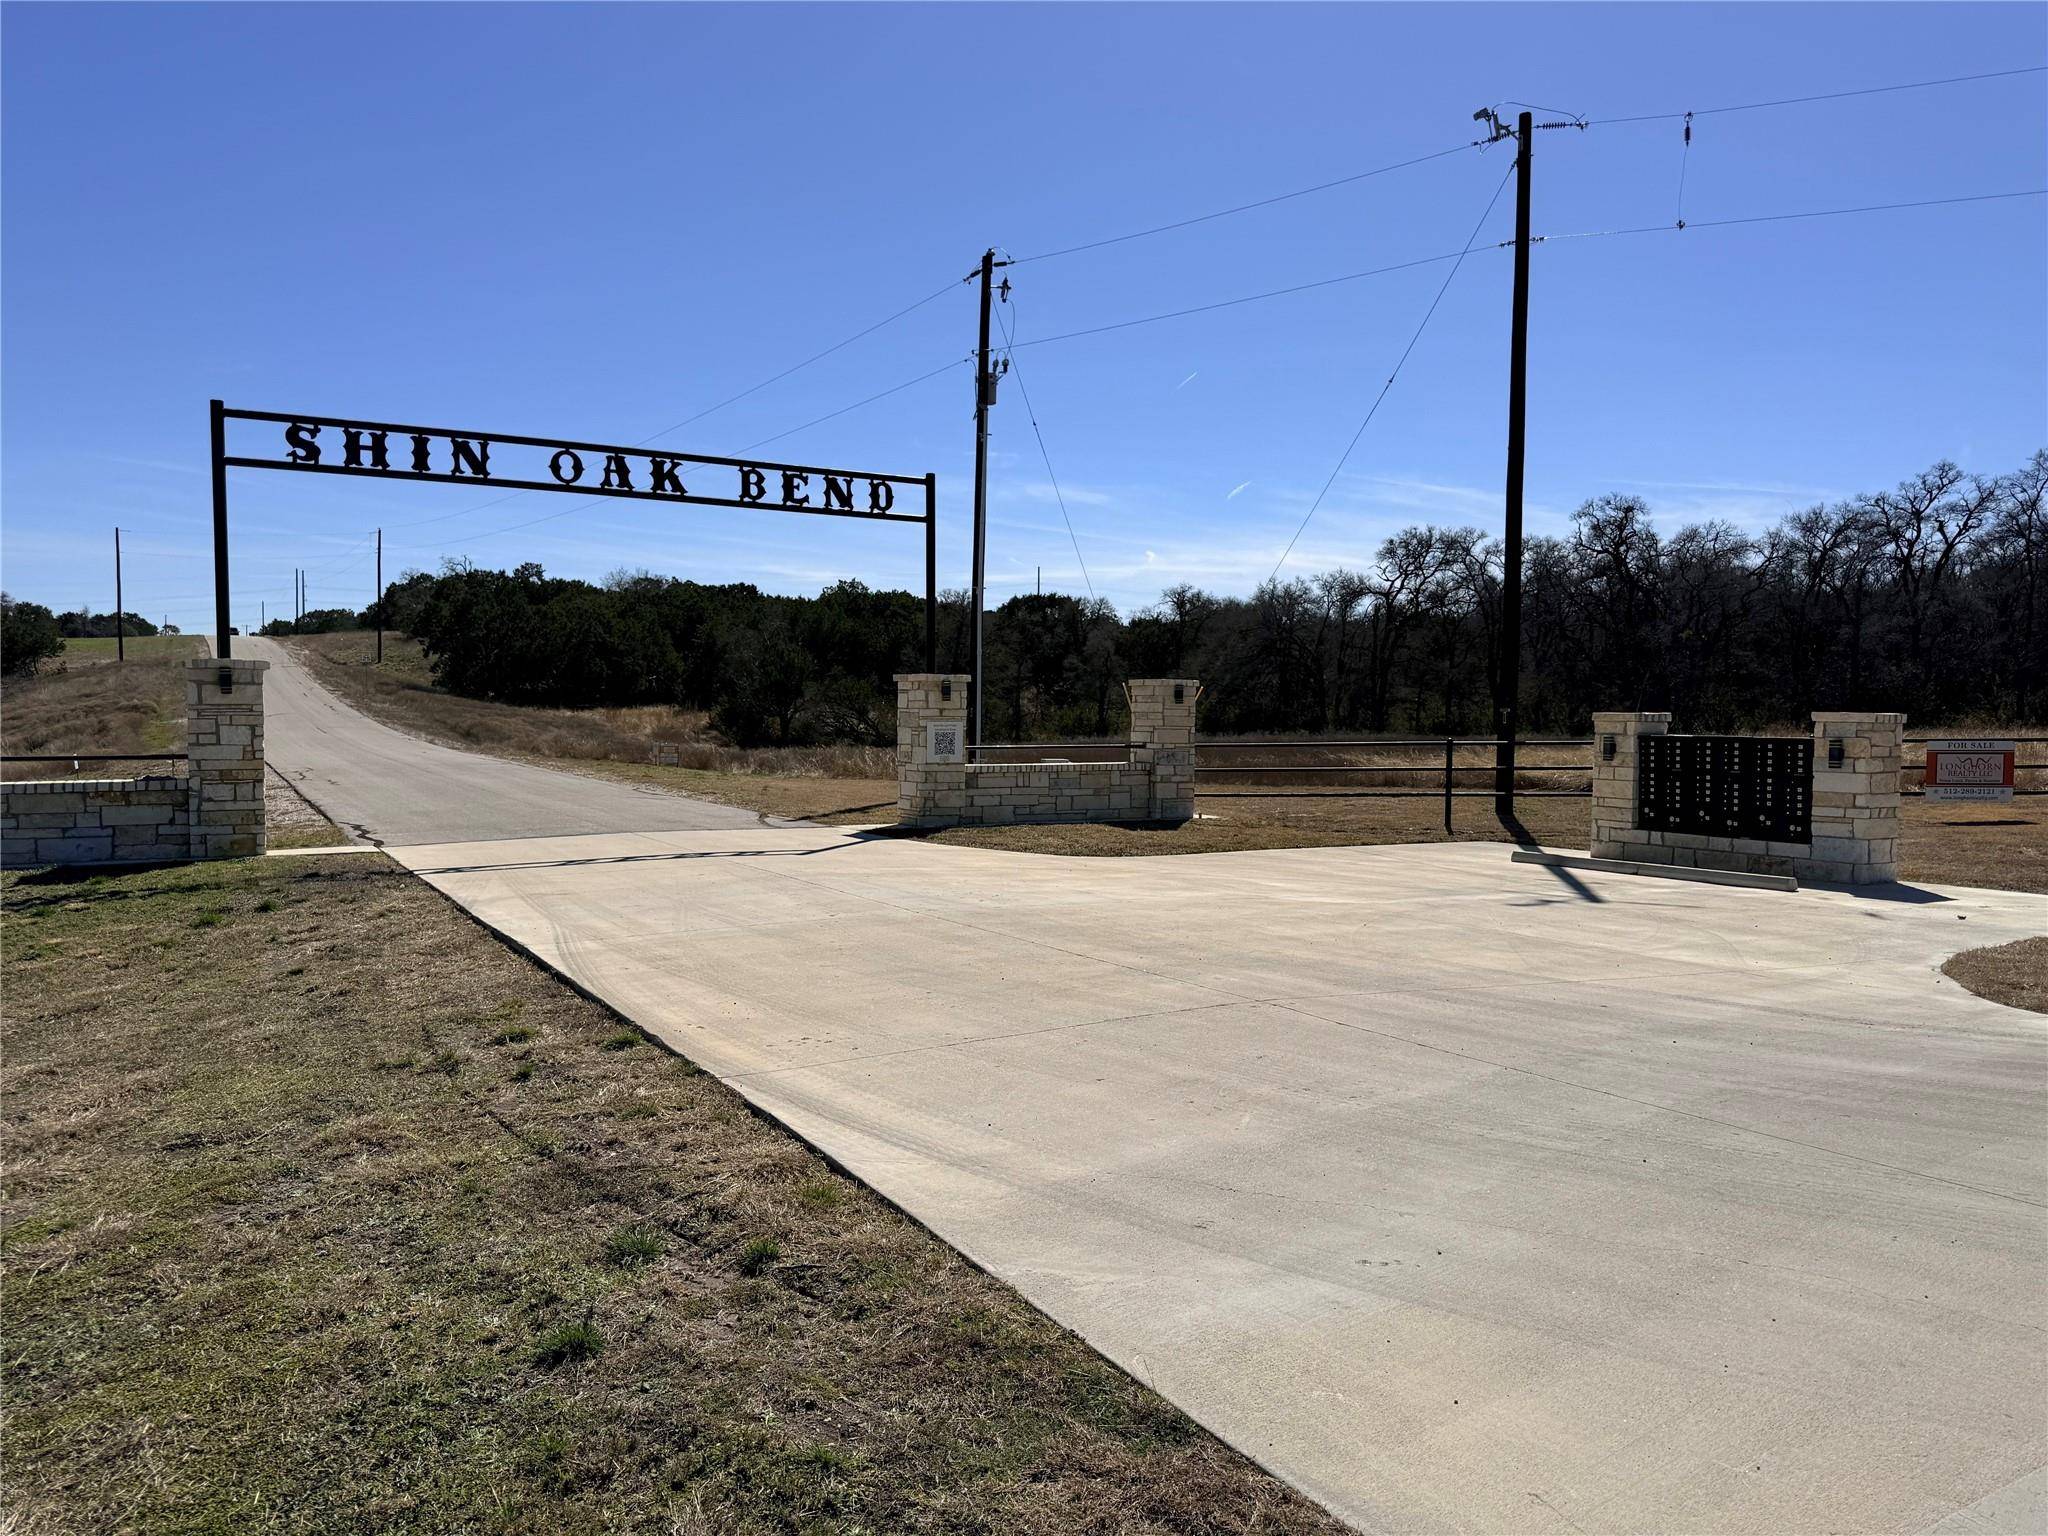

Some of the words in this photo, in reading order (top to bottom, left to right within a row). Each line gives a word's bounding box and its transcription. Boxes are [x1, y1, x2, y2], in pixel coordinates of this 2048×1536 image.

[285, 422, 490, 478] SHIN
[548, 448, 688, 495] OAK
[738, 465, 895, 514] BEND
[1940, 761, 2001, 771] LONGHORN
